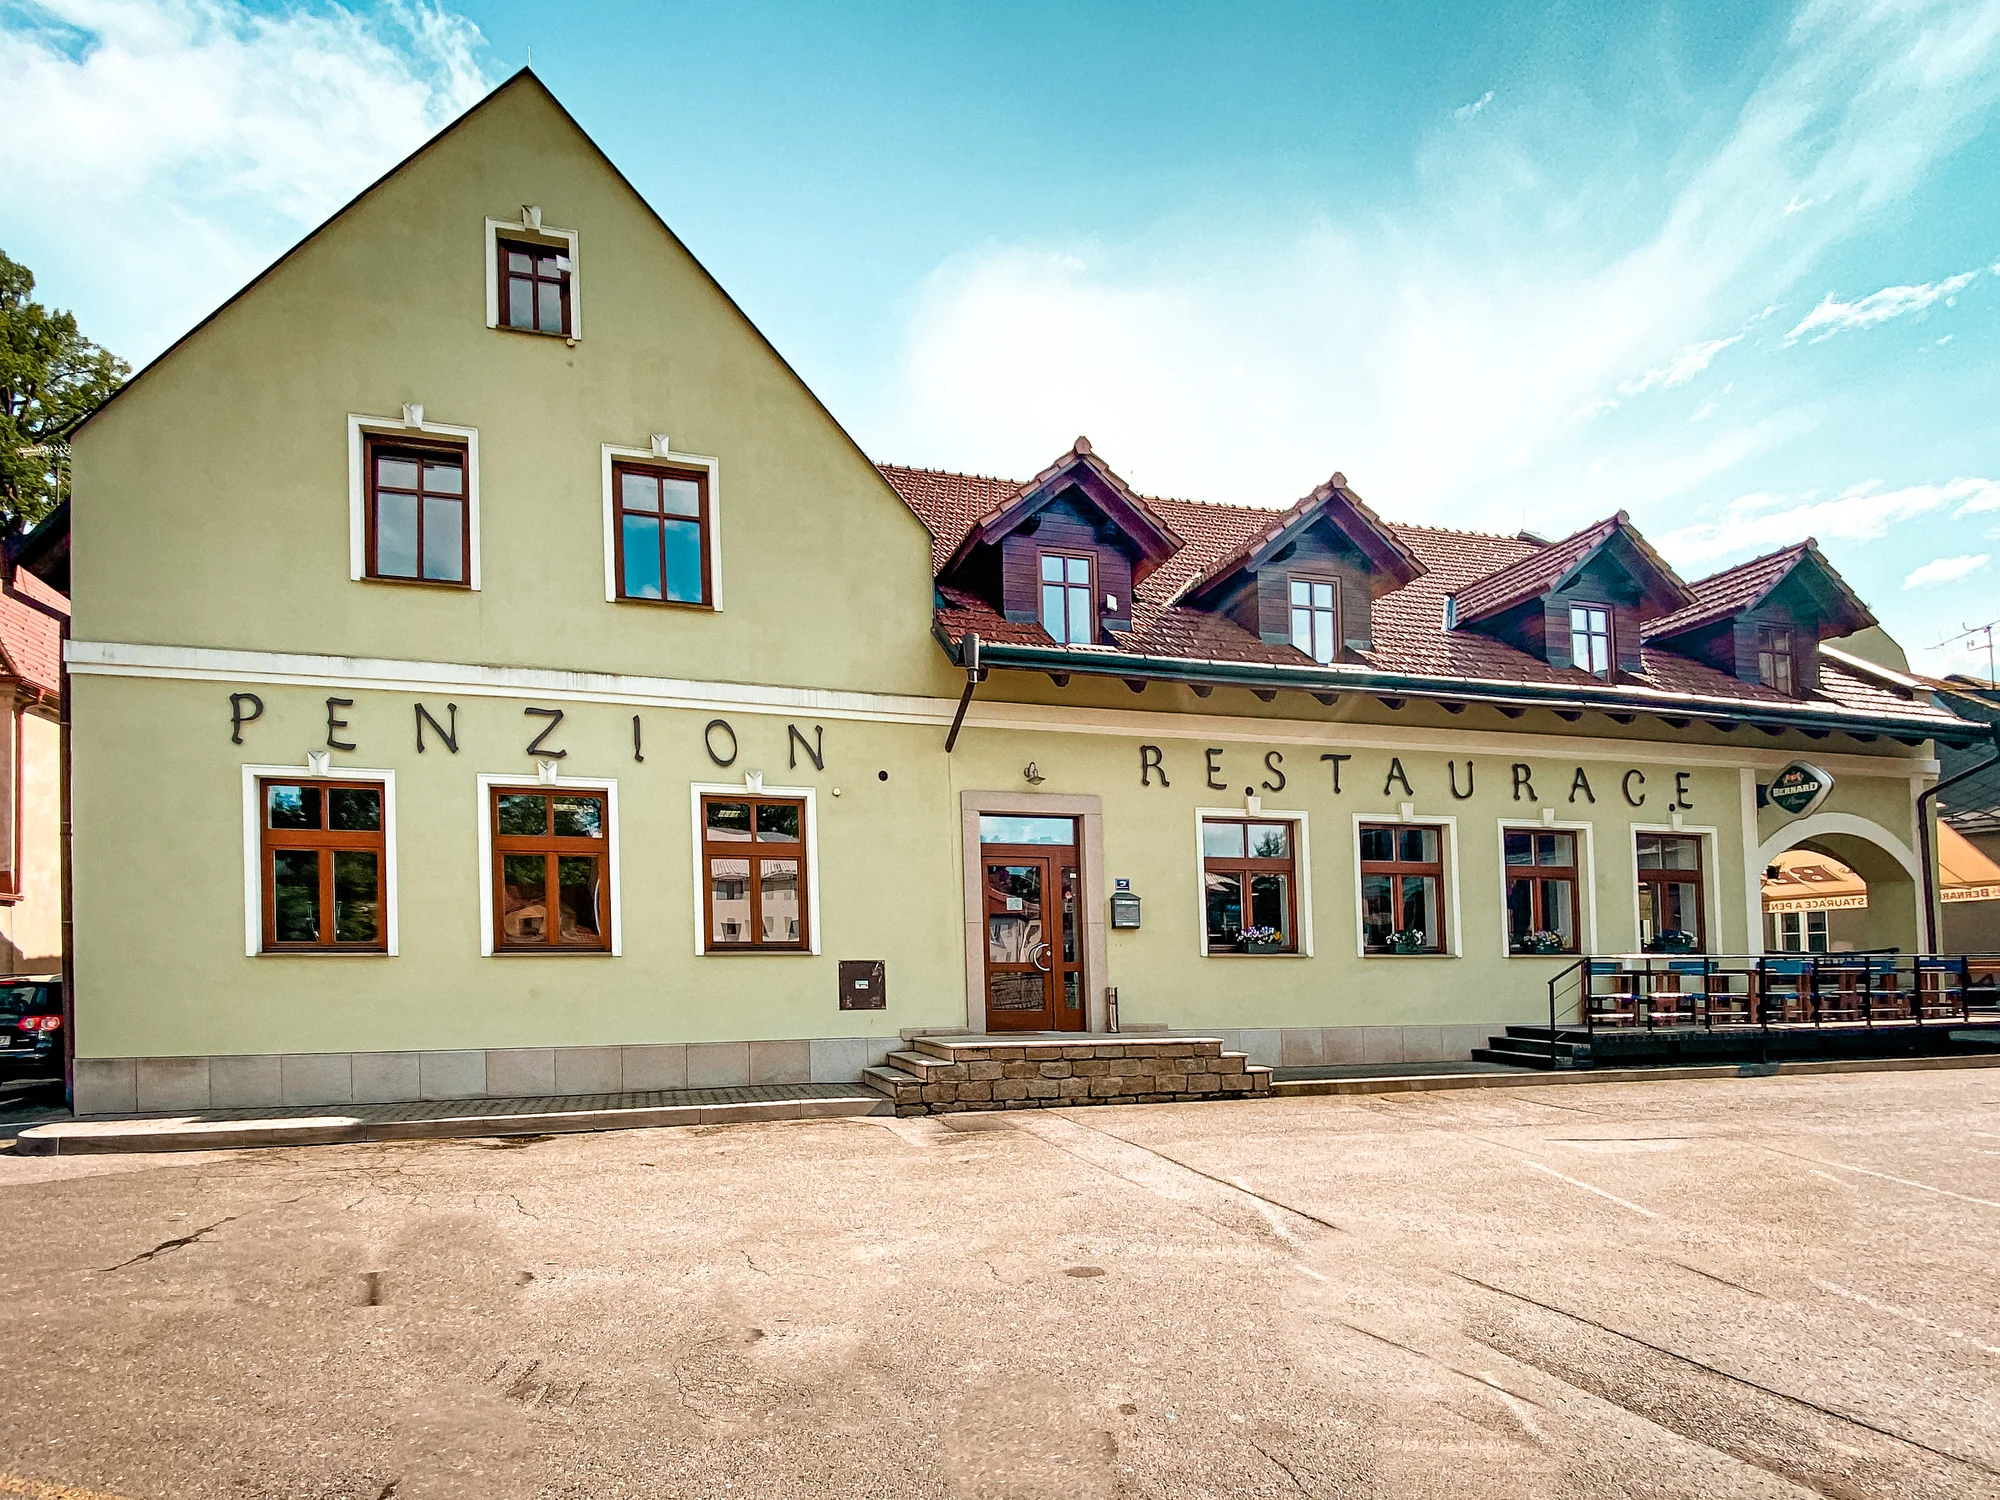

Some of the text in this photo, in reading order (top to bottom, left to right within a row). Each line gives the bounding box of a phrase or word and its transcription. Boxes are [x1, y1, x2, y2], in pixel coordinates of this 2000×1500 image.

[229, 692, 1694, 810] PENZION RESTAURACE
[1772, 782, 1818, 797] BERNARD
